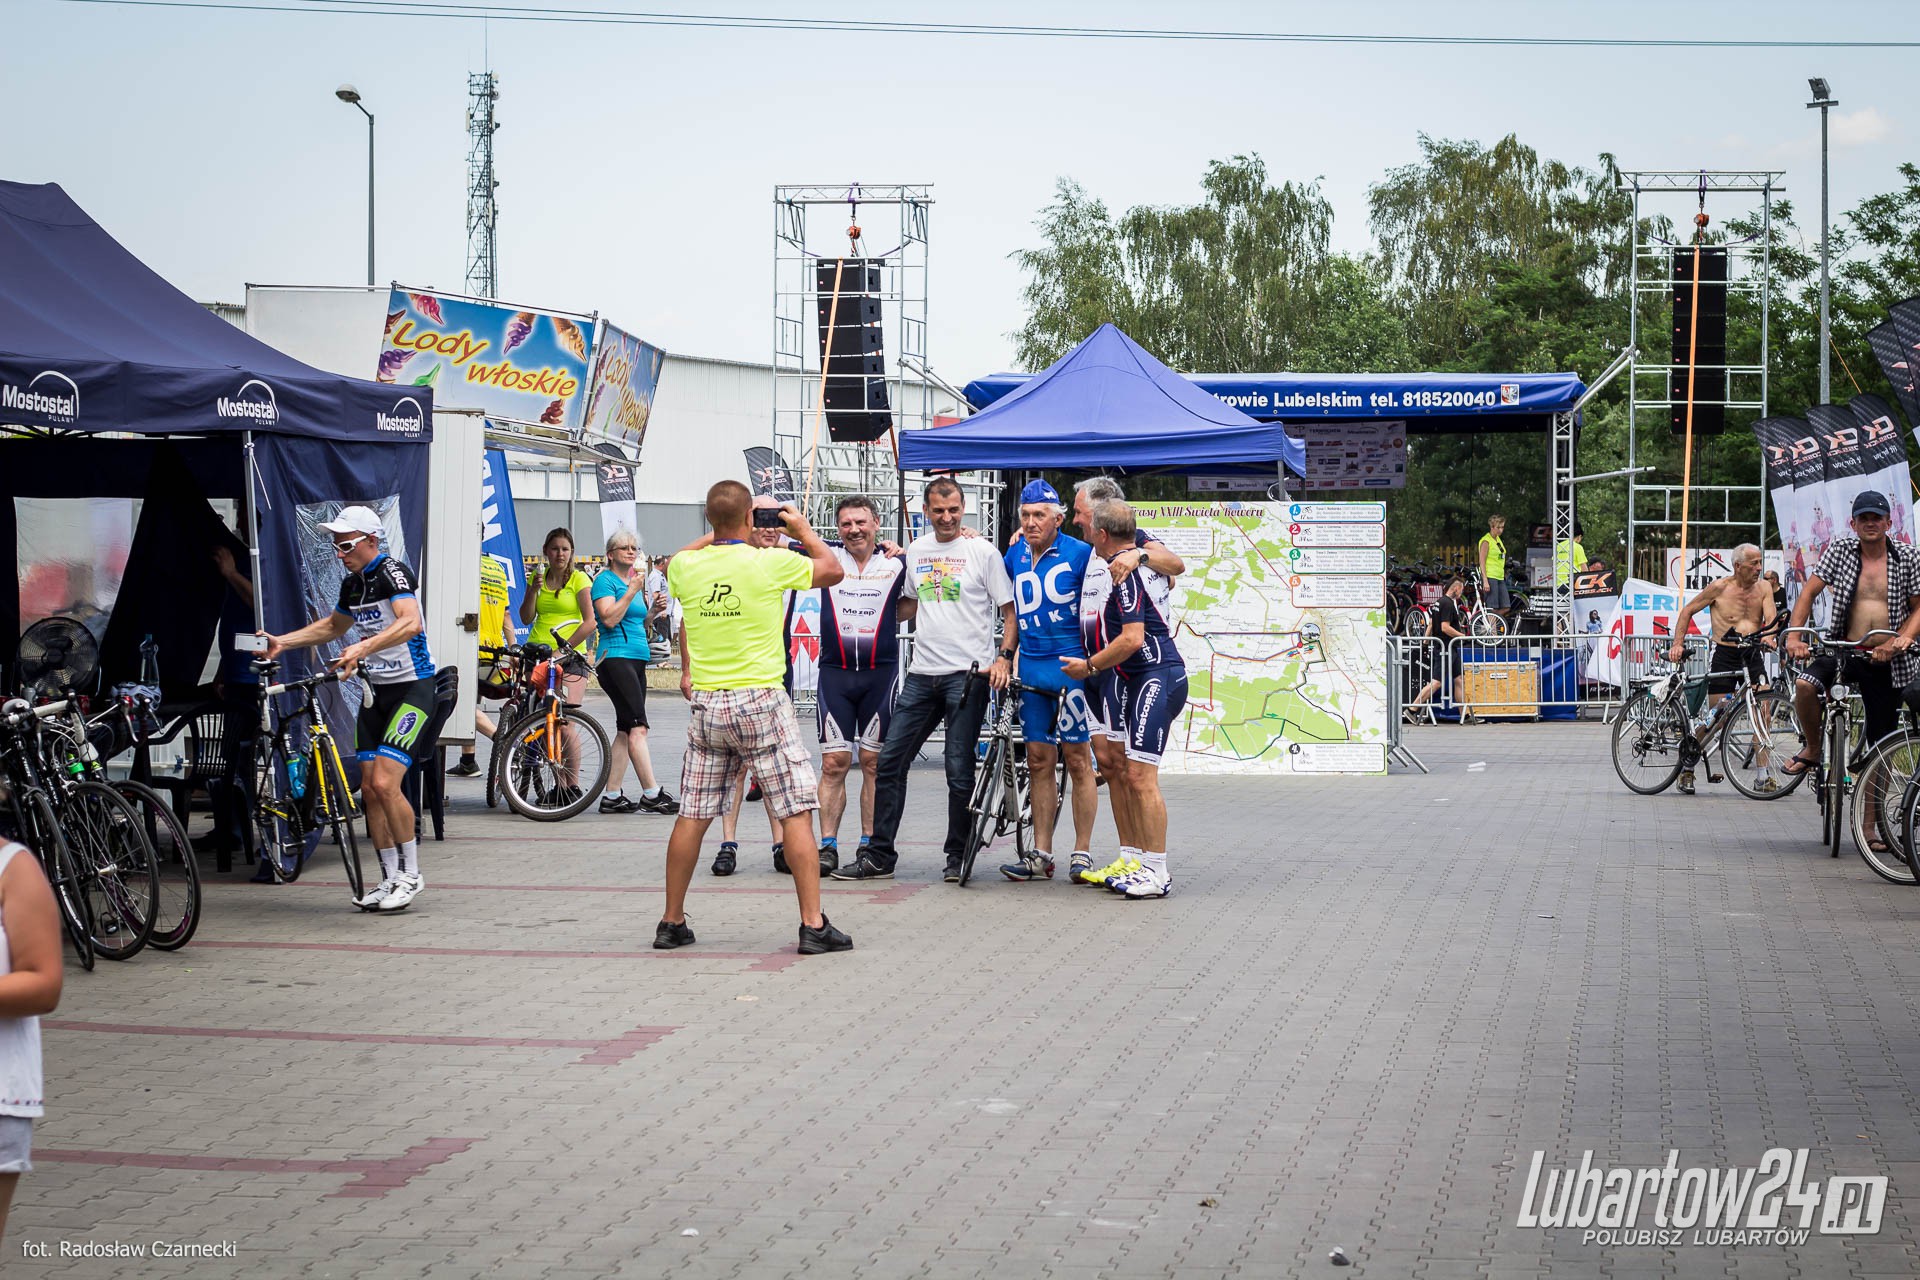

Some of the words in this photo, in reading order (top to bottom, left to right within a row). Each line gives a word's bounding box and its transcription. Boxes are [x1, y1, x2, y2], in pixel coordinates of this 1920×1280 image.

[391, 321, 490, 364] Lody
[467, 362, 577, 398] włoskie
[2, 384, 75, 417] Mostostal
[217, 397, 276, 420] Mostostal
[1274, 391, 1363, 408] Lubelskim
[1370, 391, 1399, 408] tel.
[1402, 390, 1497, 407] 818520040
[376, 411, 421, 432] Mostostal
[1574, 572, 1613, 590] CK
[1134, 683, 1160, 747] Mostostal
